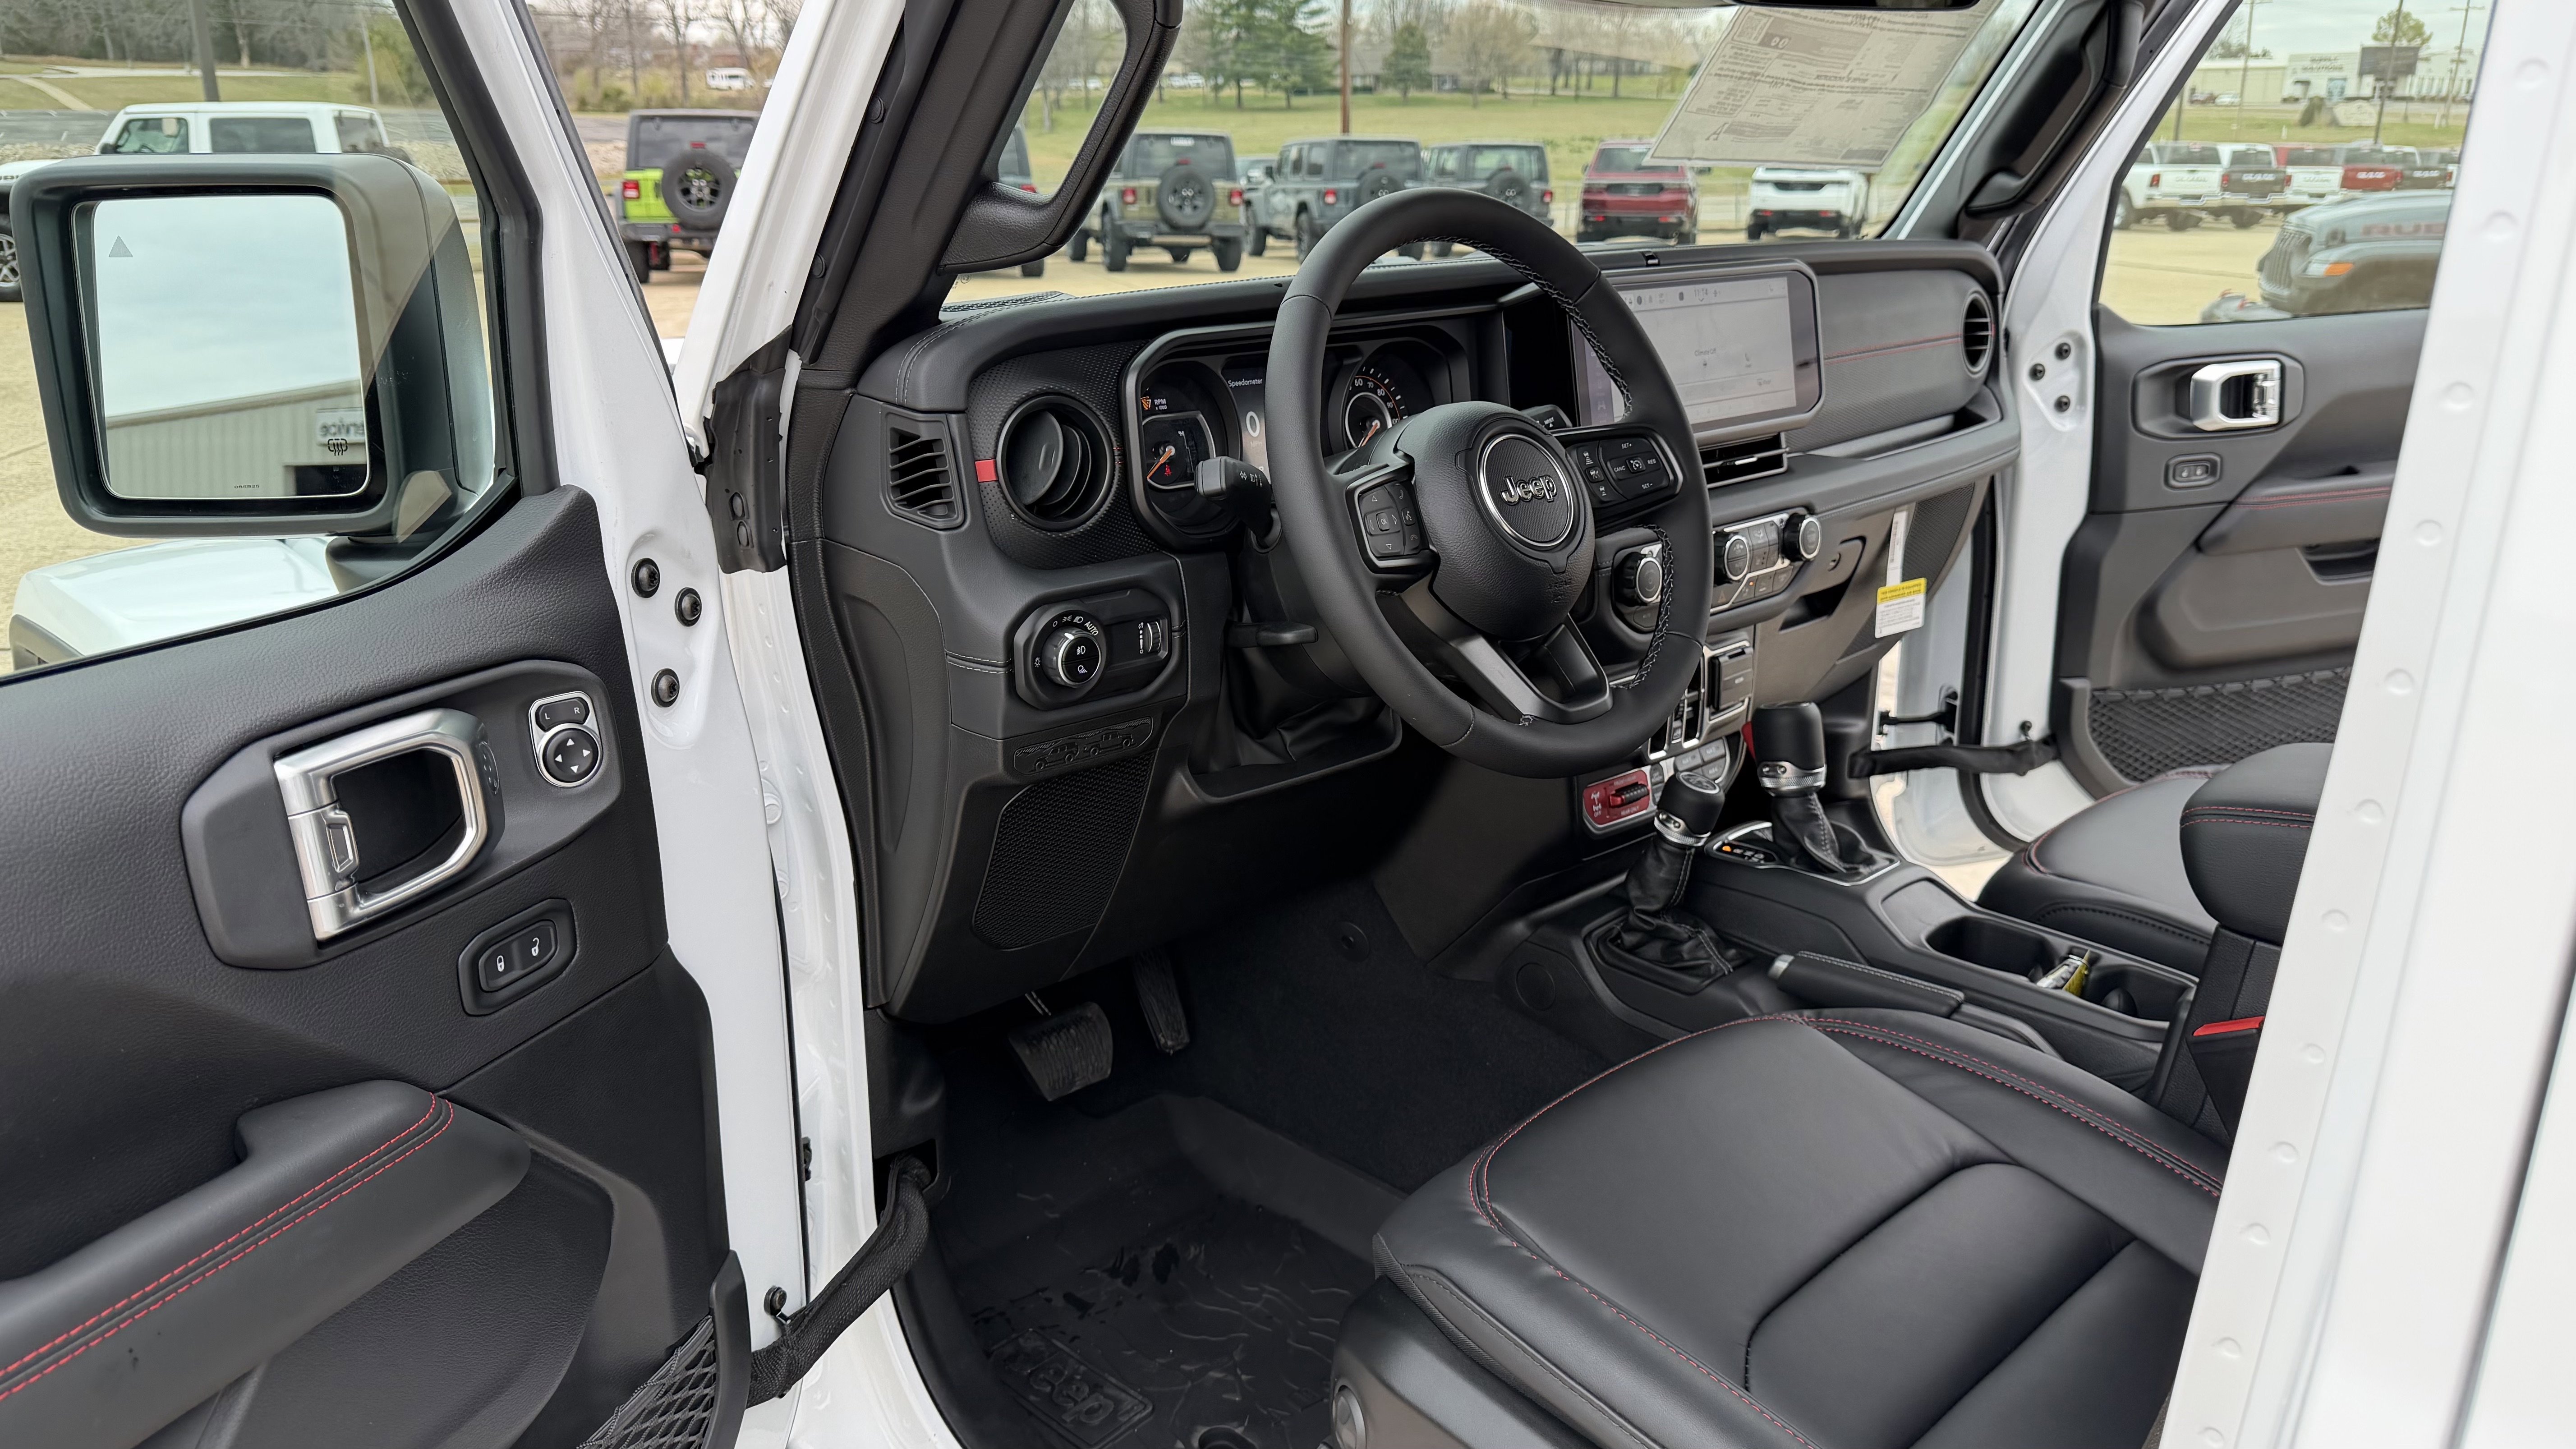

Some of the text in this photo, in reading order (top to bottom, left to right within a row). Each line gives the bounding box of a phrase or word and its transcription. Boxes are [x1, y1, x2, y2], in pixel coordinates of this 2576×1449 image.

[1228, 378, 1263, 388] Speedometer
[1354, 378, 1363, 386] 60
[1246, 411, 1260, 437] 0
[1500, 474, 1557, 506] Jeep
[1084, 621, 1099, 636] AUTO
